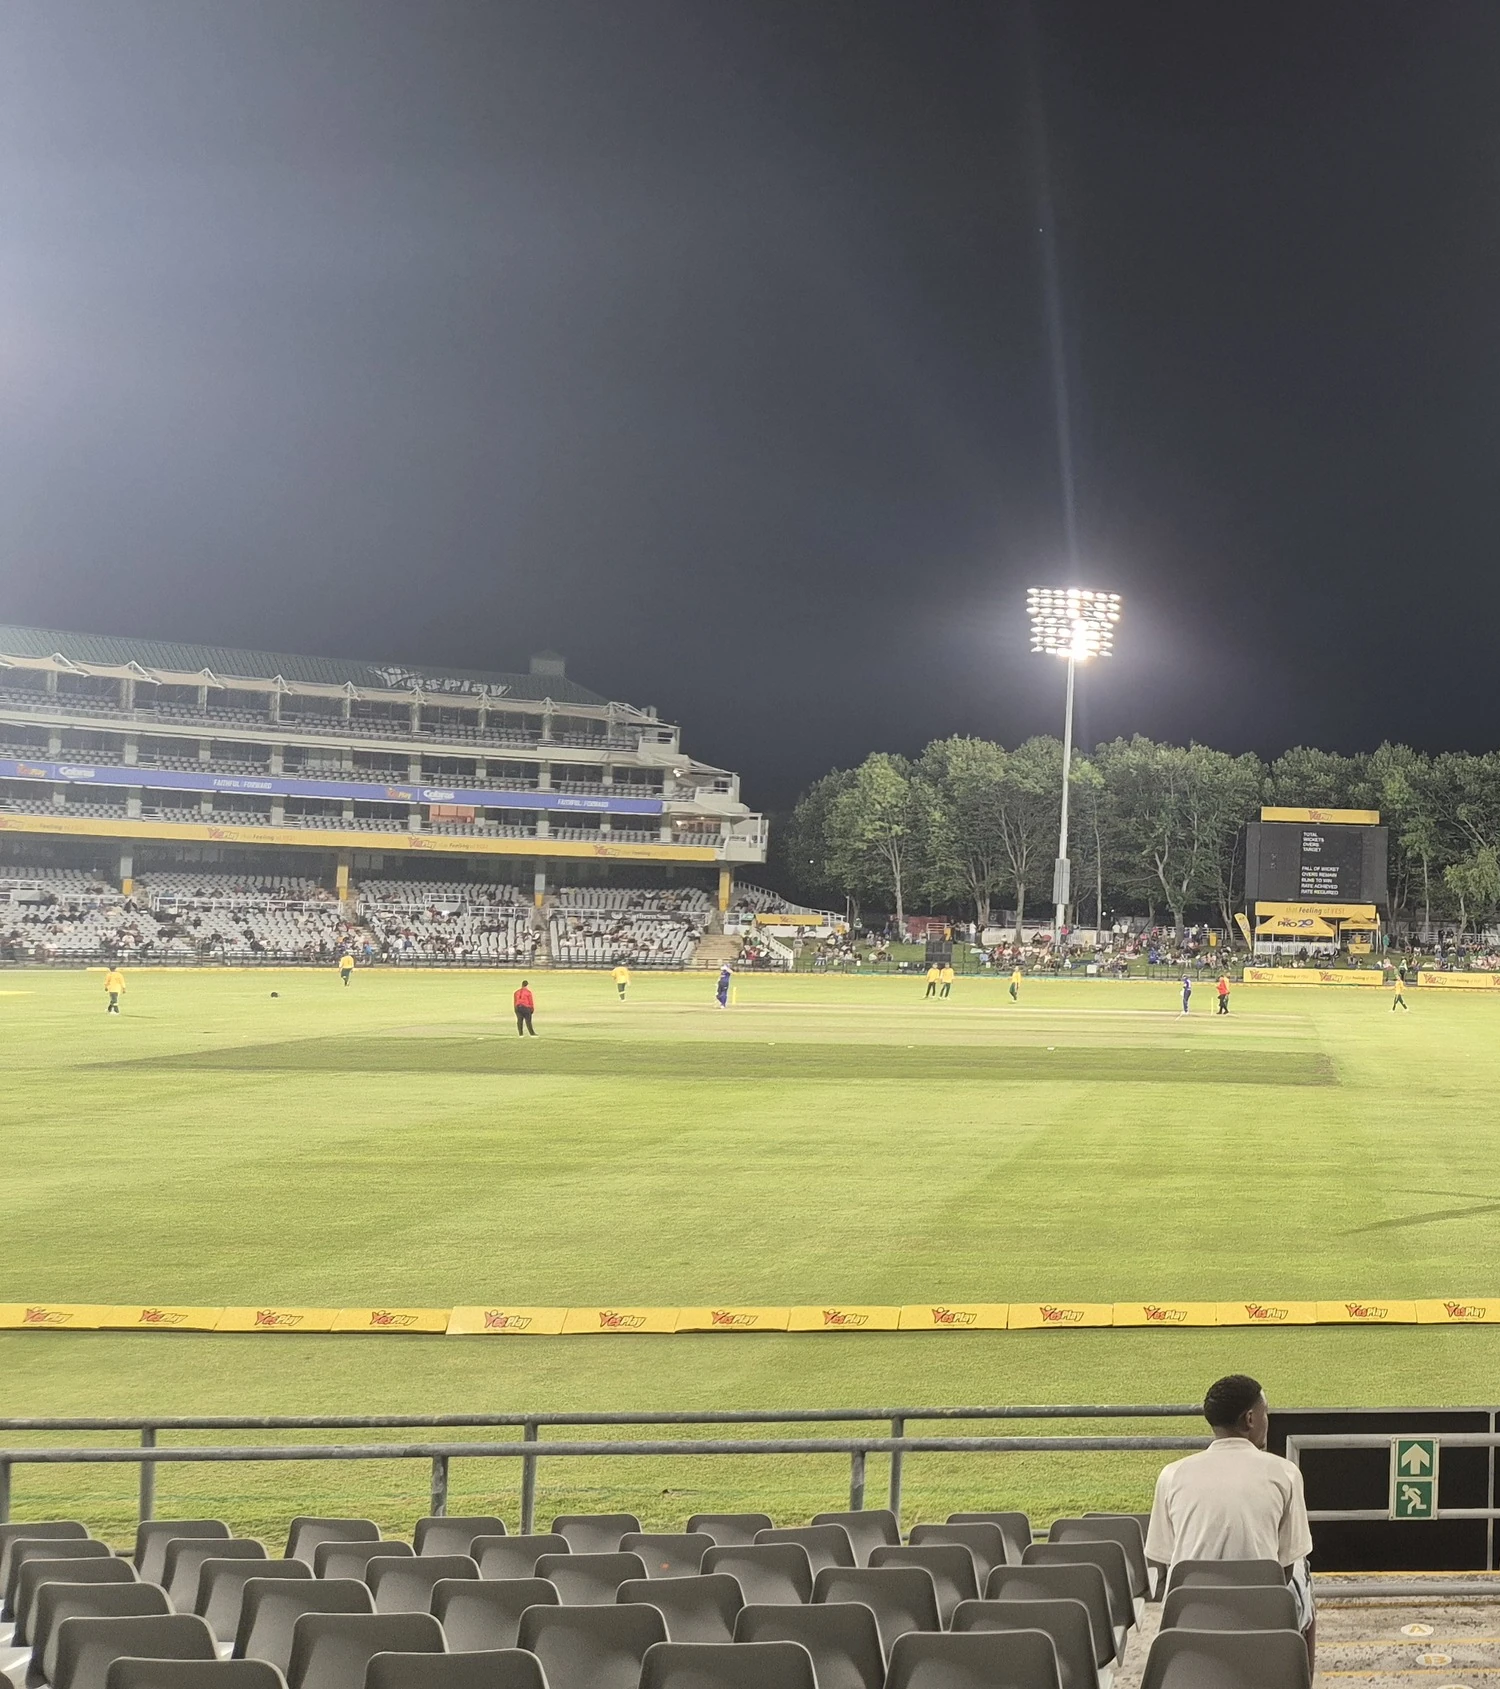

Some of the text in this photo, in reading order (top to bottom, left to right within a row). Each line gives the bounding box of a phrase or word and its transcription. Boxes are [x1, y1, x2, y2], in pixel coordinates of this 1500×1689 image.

[254, 1310, 304, 1326] YesPlay
[823, 1308, 869, 1326] YesPlay
[931, 1306, 977, 1324] YesPlay
[1039, 1305, 1084, 1322] YesPlay
[1143, 1303, 1188, 1322] YesPlay
[1244, 1303, 1289, 1320] YesPlay
[1344, 1302, 1388, 1318] YesPlay
[1443, 1301, 1486, 1318] YesPlay
[484, 1310, 533, 1329] YesPlay
[599, 1310, 646, 1328] YesPlay
[1409, 1625, 1427, 1633] A
[1424, 1655, 1448, 1665] B
